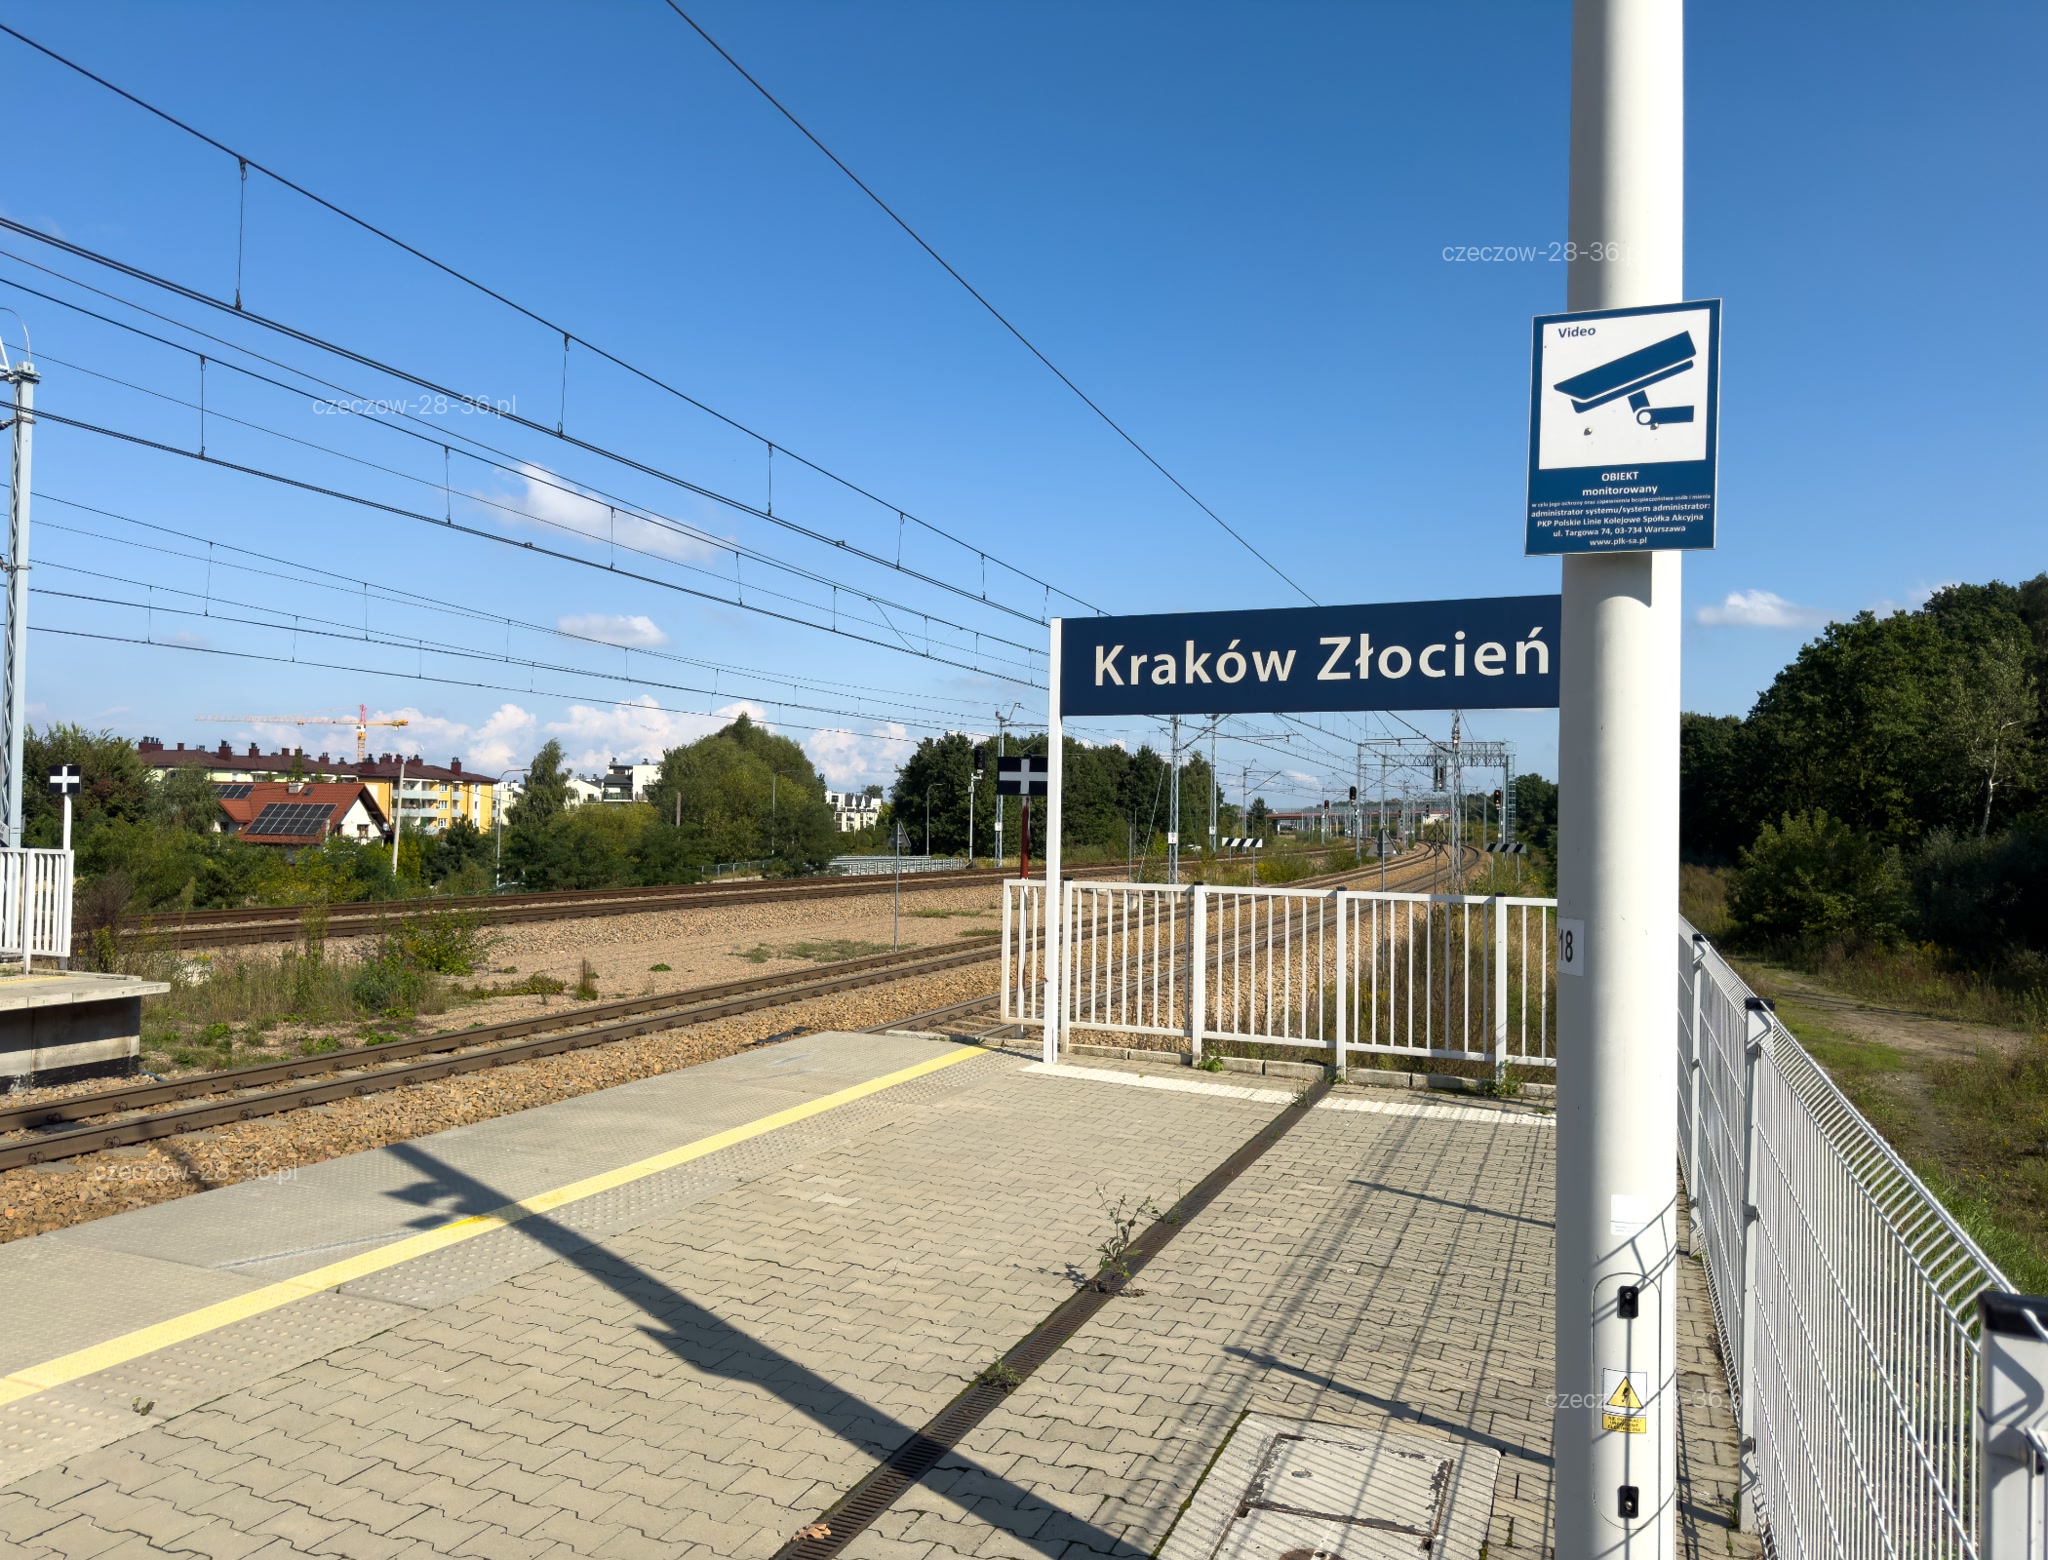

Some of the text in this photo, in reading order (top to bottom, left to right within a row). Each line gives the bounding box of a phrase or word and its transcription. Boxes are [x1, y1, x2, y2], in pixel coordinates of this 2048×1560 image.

[1558, 327, 1596, 338] Video
[1601, 472, 1639, 482] OBIEKT
[1582, 485, 1658, 496] monitorowany
[1531, 503, 1711, 517] administrator systemu/system administrator:
[1554, 518, 1581, 526] Polskie
[1604, 516, 1641, 525] Kolejowe
[1643, 514, 1670, 523] Spółka
[1672, 513, 1704, 522] Akcyjna
[1565, 529, 1599, 537] Targowa
[1601, 527, 1613, 535] 74,
[1614, 526, 1642, 534] 03-734
[1644, 525, 1686, 533] Warszawa
[1589, 536, 1648, 546] www.plk-sa.pl
[1095, 626, 1550, 686] Kraków Złocień
